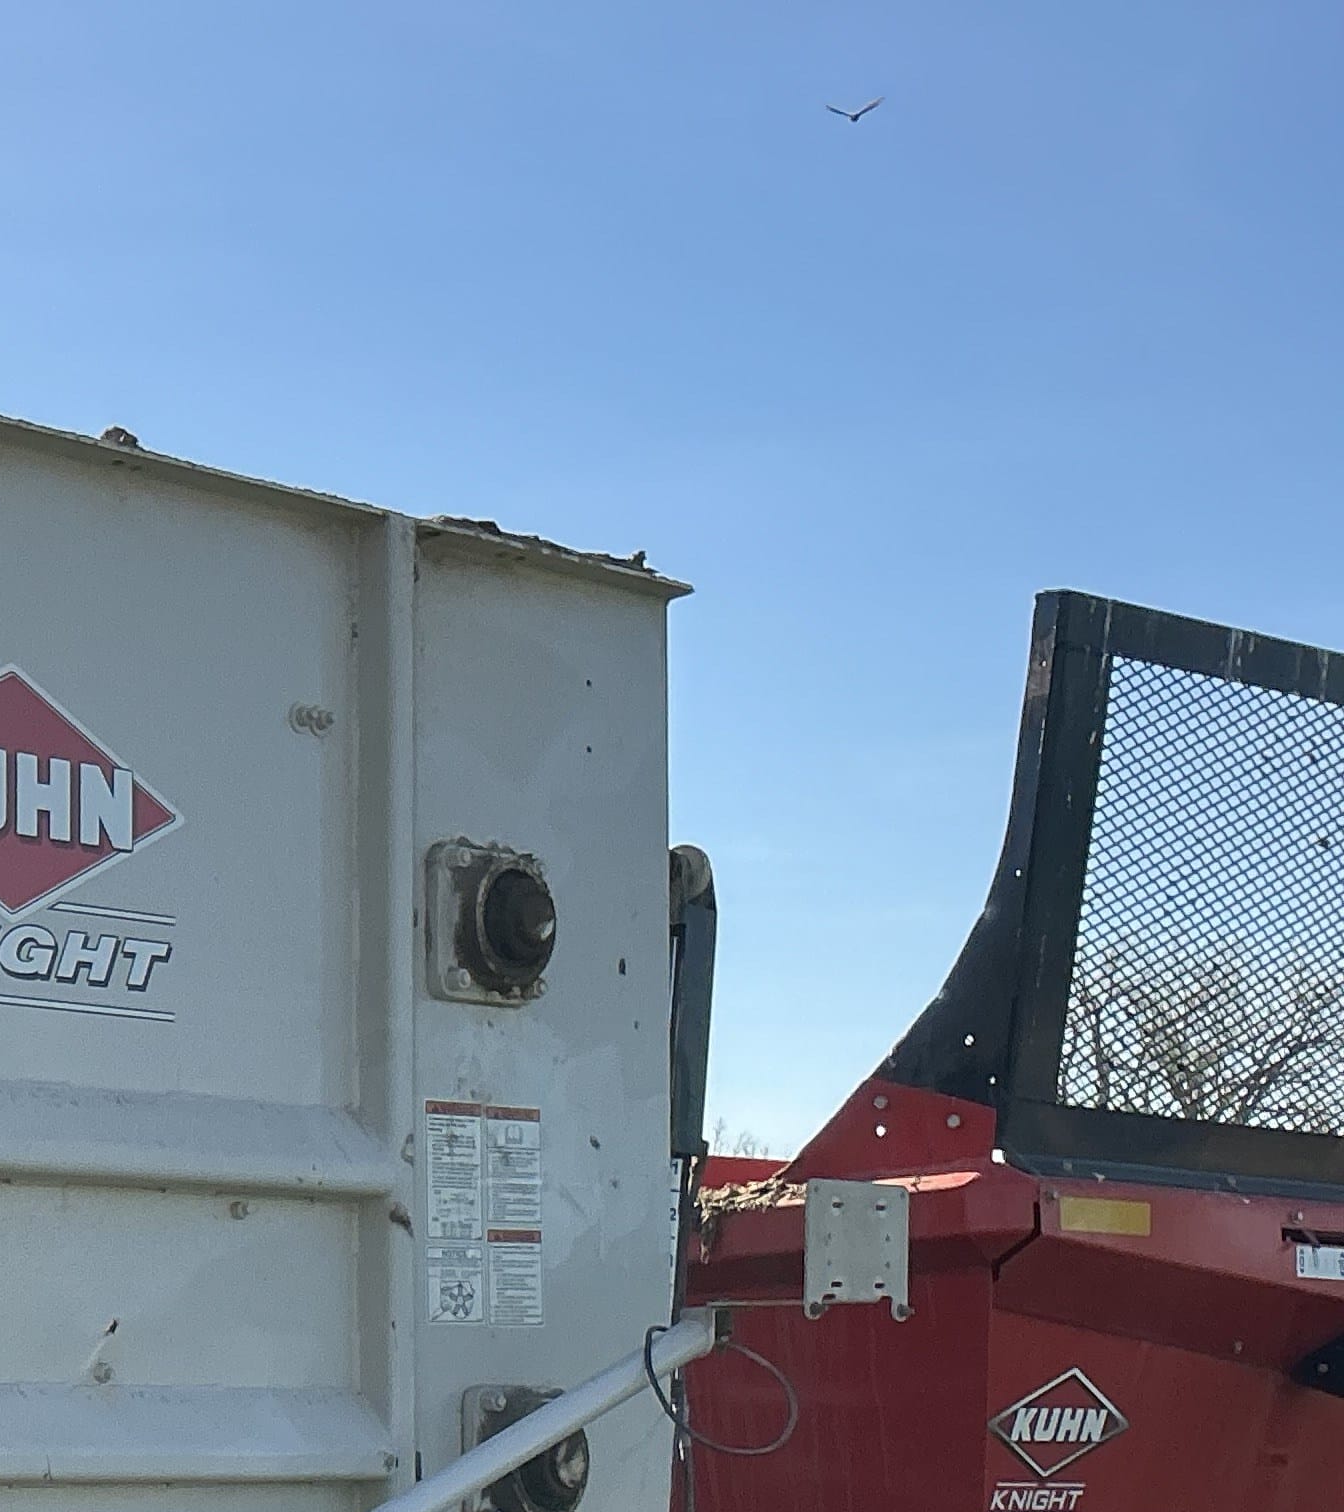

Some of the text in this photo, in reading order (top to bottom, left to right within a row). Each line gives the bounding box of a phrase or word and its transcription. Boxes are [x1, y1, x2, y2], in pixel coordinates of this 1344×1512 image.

[669, 1207, 677, 1221] 2
[1010, 1407, 1109, 1442] KUHN
[989, 1489, 1084, 1511] KNIGHT
